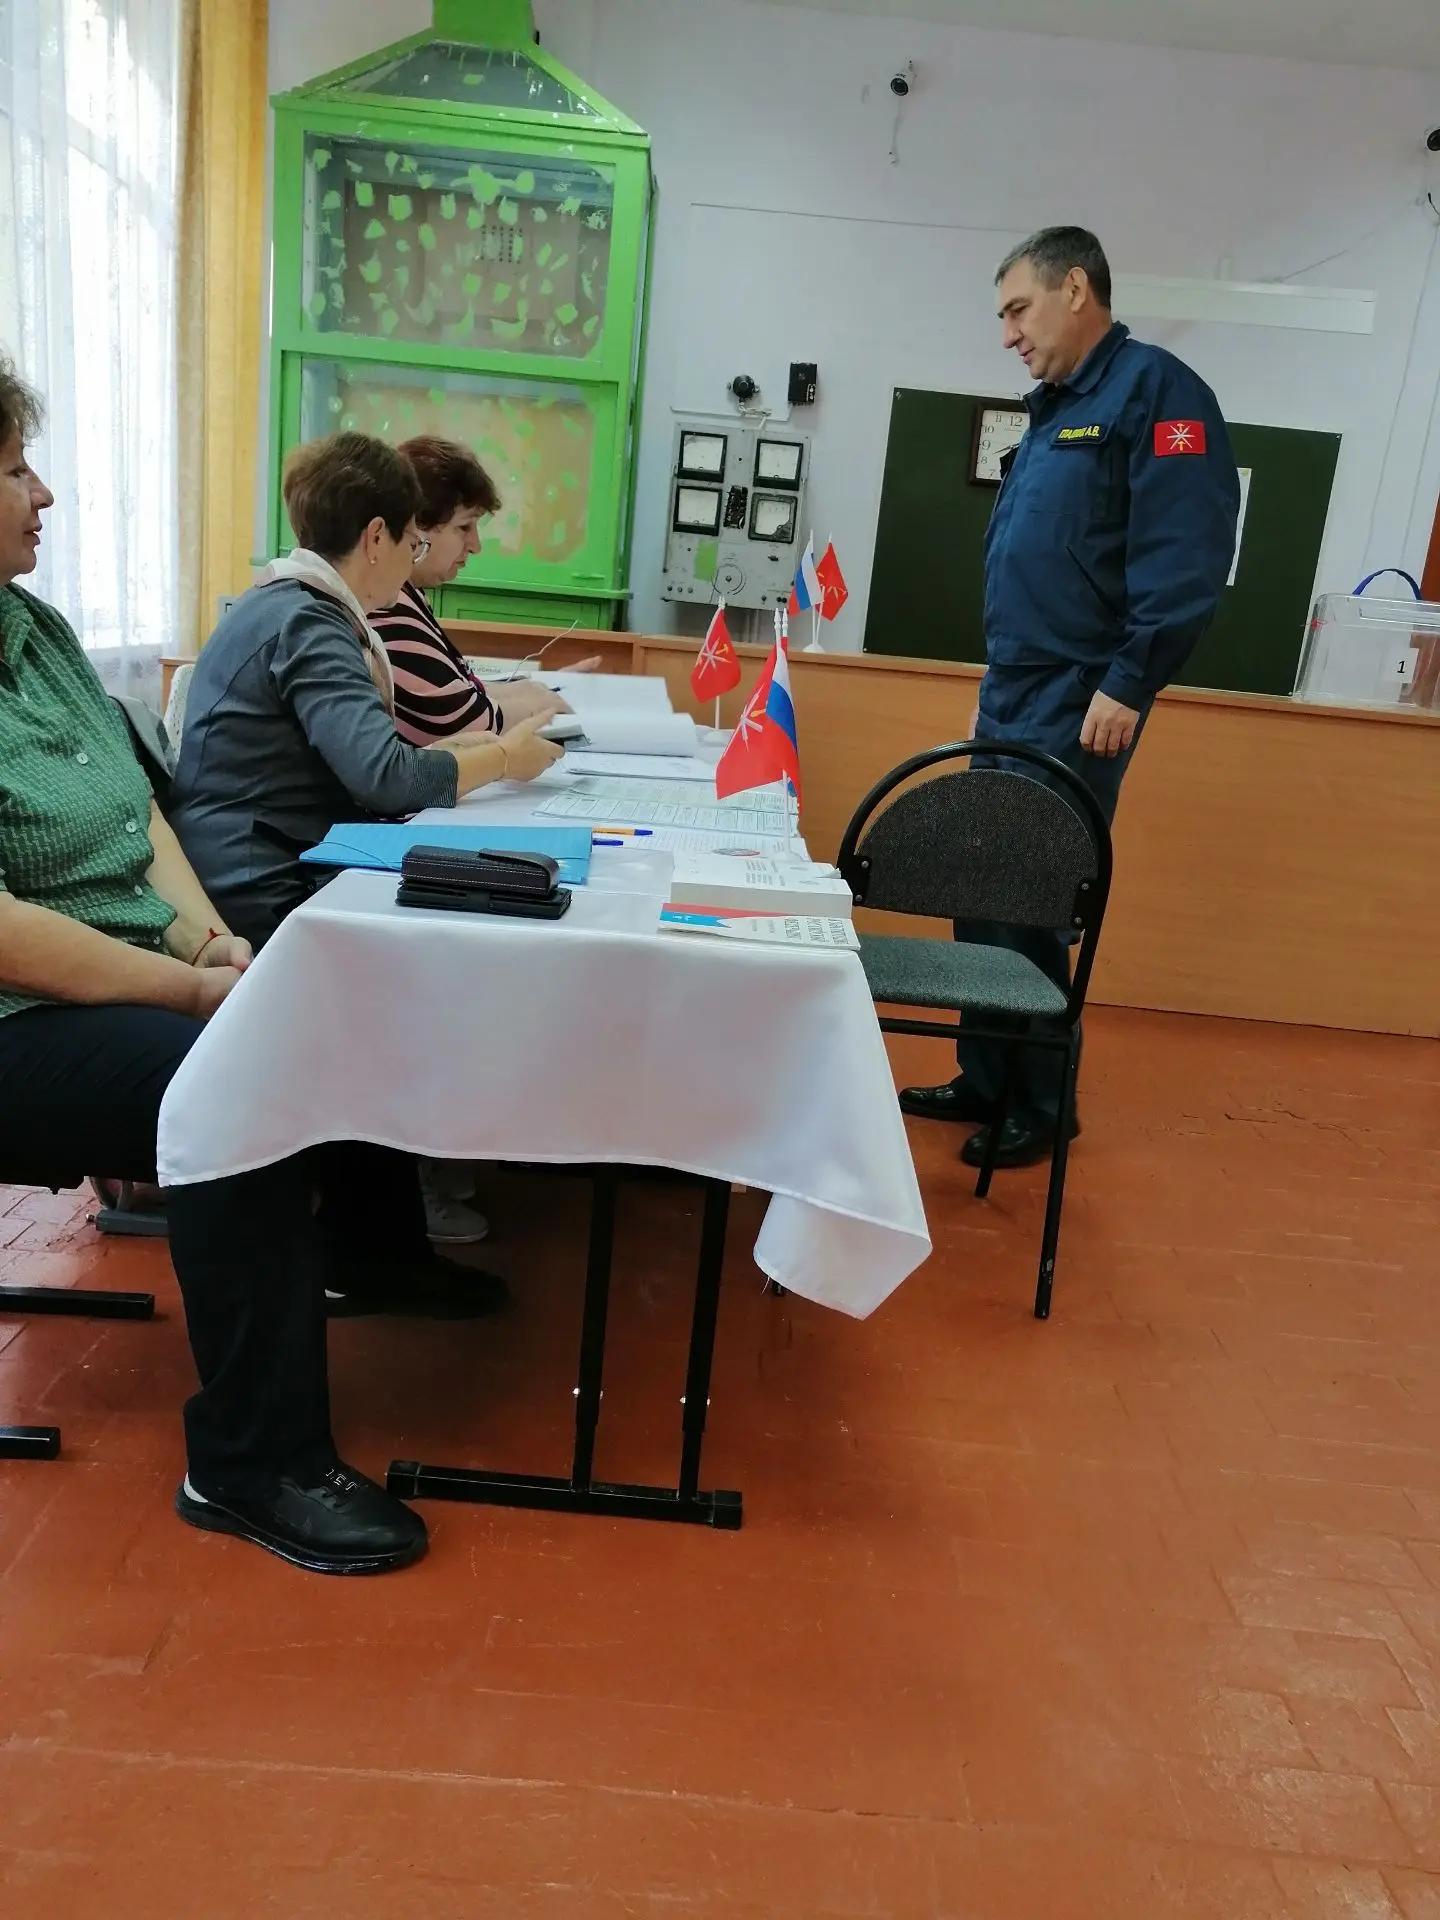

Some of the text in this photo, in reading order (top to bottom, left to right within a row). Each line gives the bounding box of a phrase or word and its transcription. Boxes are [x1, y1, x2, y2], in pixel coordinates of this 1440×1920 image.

[1009, 415, 1023, 427] 12
[984, 425, 995, 433] 10
[981, 440, 991, 451] 9
[989, 469, 996, 478] 7
[1397, 661, 1405, 673] 1
